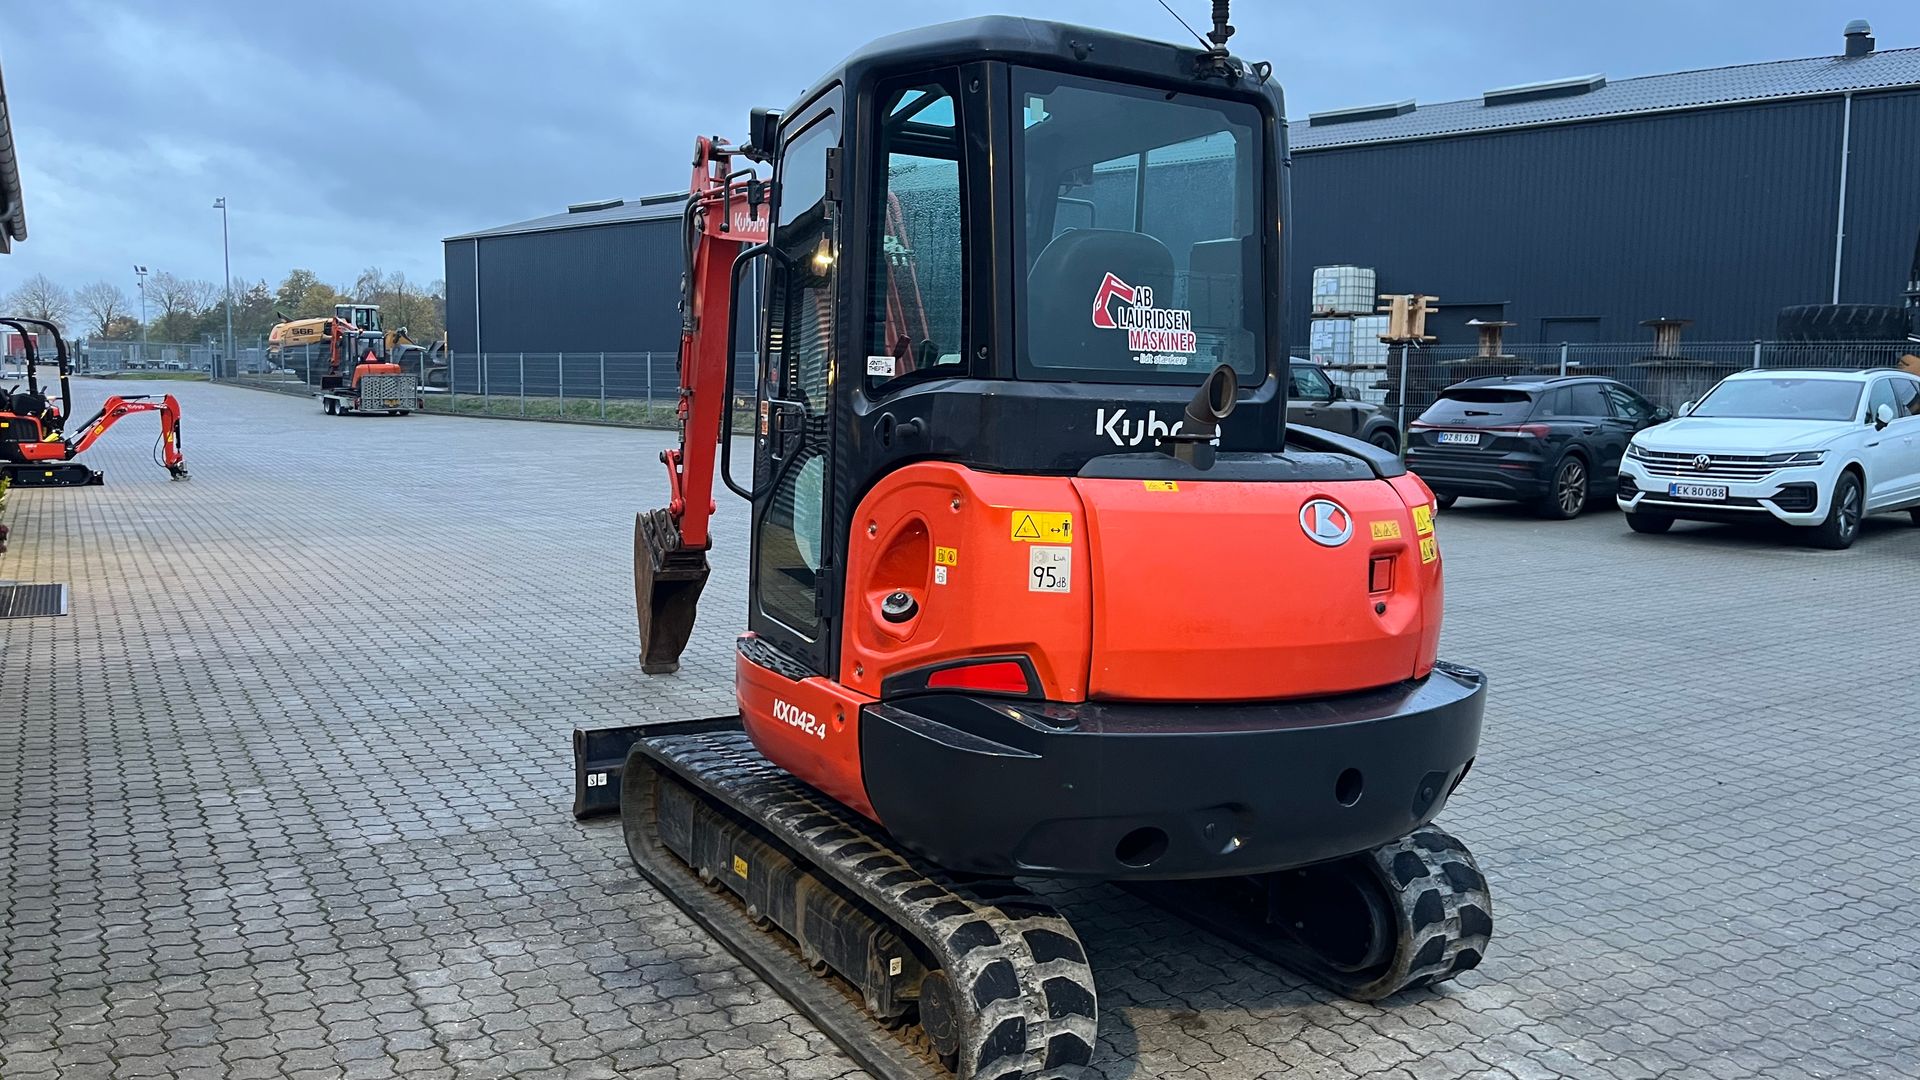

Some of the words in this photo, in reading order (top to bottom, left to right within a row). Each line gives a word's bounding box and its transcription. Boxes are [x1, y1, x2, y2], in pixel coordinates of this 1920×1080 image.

[1135, 288, 1152, 307] AB
[1119, 307, 1190, 331] LAURIDSEN
[1130, 331, 1195, 351] MASKINER
[1096, 408, 1221, 447] Kub
[1464, 434, 1477, 442] 631
[1677, 485, 1689, 495] EK
[1691, 487, 1704, 496] 80
[1705, 488, 1724, 498] 088
[773, 698, 826, 740] KX042-4
